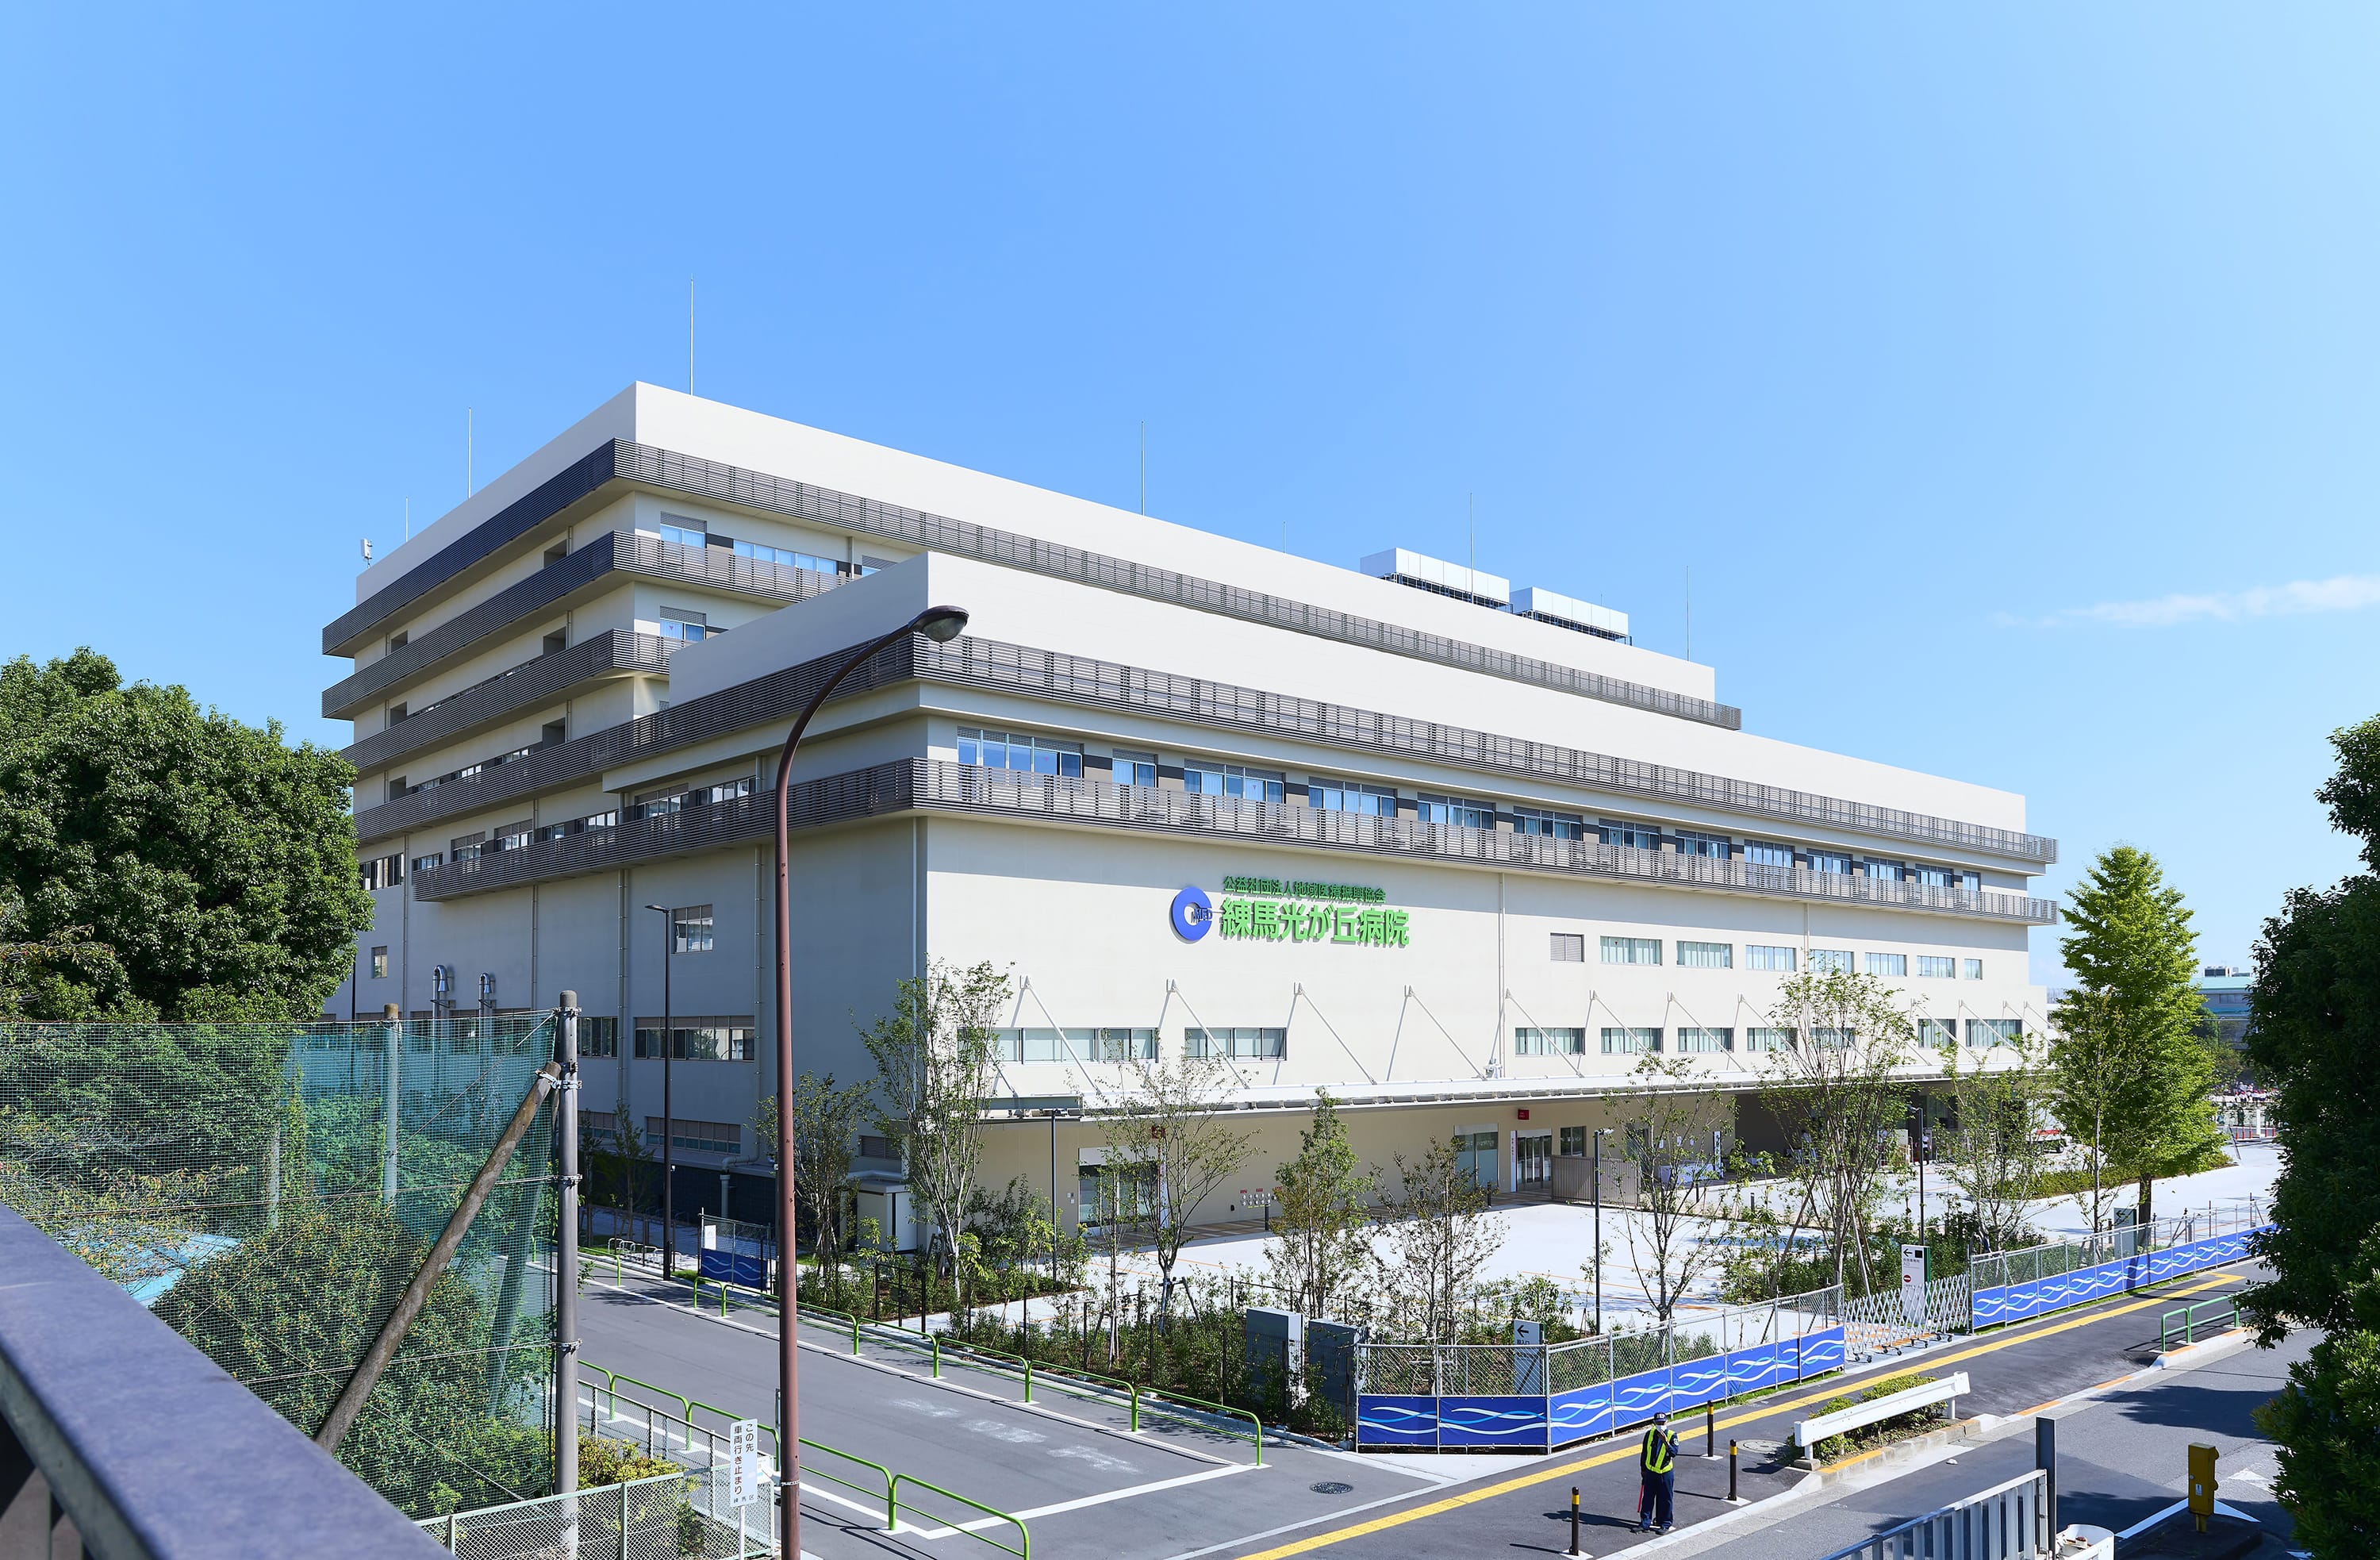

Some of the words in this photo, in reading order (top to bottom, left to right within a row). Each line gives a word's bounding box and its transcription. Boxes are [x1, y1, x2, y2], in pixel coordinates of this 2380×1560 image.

[1223, 875, 1386, 903] 公益社団法人地域医療振興協会
[1223, 897, 1410, 945] 練馬光が丘病院
